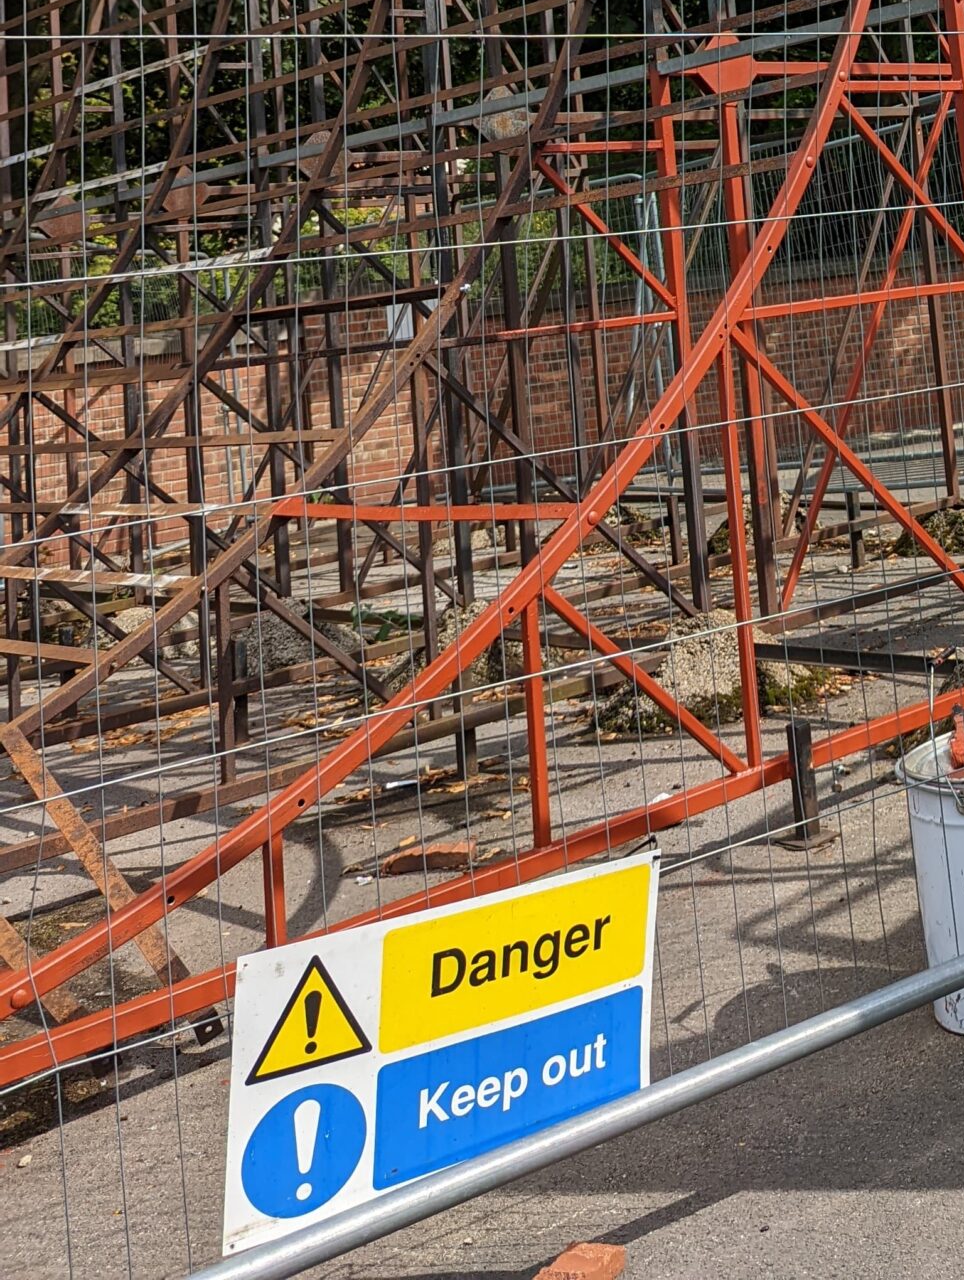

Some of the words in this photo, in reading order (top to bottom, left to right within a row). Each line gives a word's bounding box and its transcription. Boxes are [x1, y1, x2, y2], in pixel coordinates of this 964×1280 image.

[430, 914, 611, 998] Danger
[418, 1067, 528, 1129] Keep
[541, 1033, 607, 1086] out
